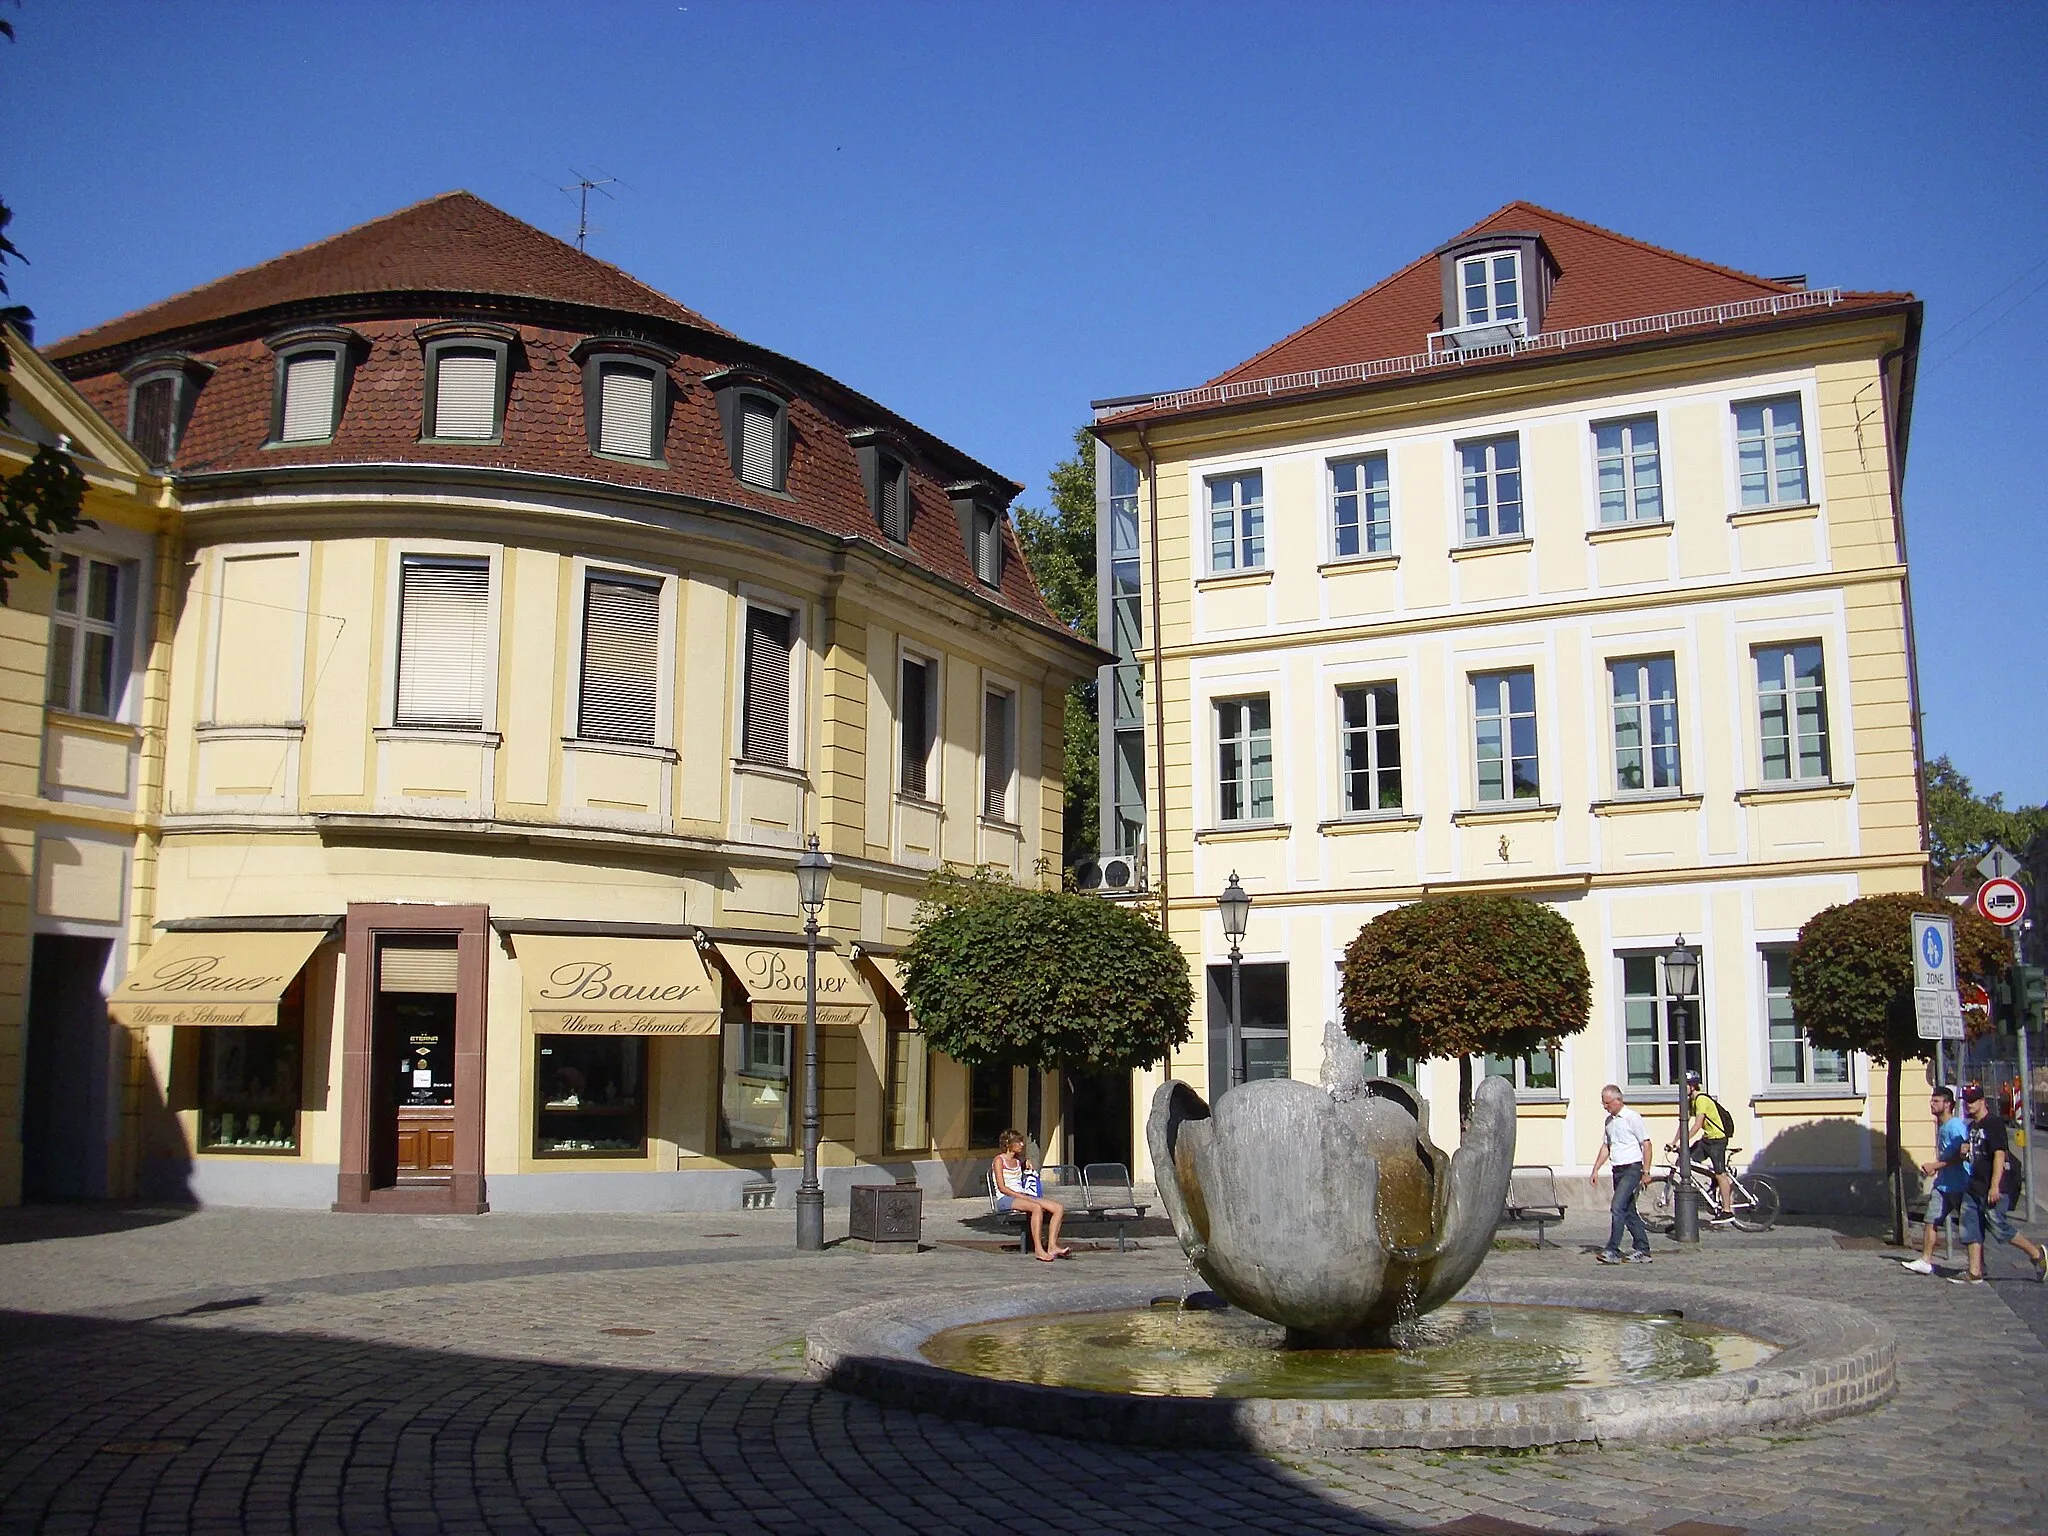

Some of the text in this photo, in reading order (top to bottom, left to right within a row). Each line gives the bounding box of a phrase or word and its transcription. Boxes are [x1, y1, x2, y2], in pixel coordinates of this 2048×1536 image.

[129, 956, 283, 991] Bauer
[540, 961, 700, 1000] Bauer
[1926, 973, 1944, 985] ZONE
[133, 1005, 247, 1023] Uhren & Schmuck
[771, 1004, 799, 1021] Uhren
[561, 1014, 692, 1033] Uhren & Schmuck
